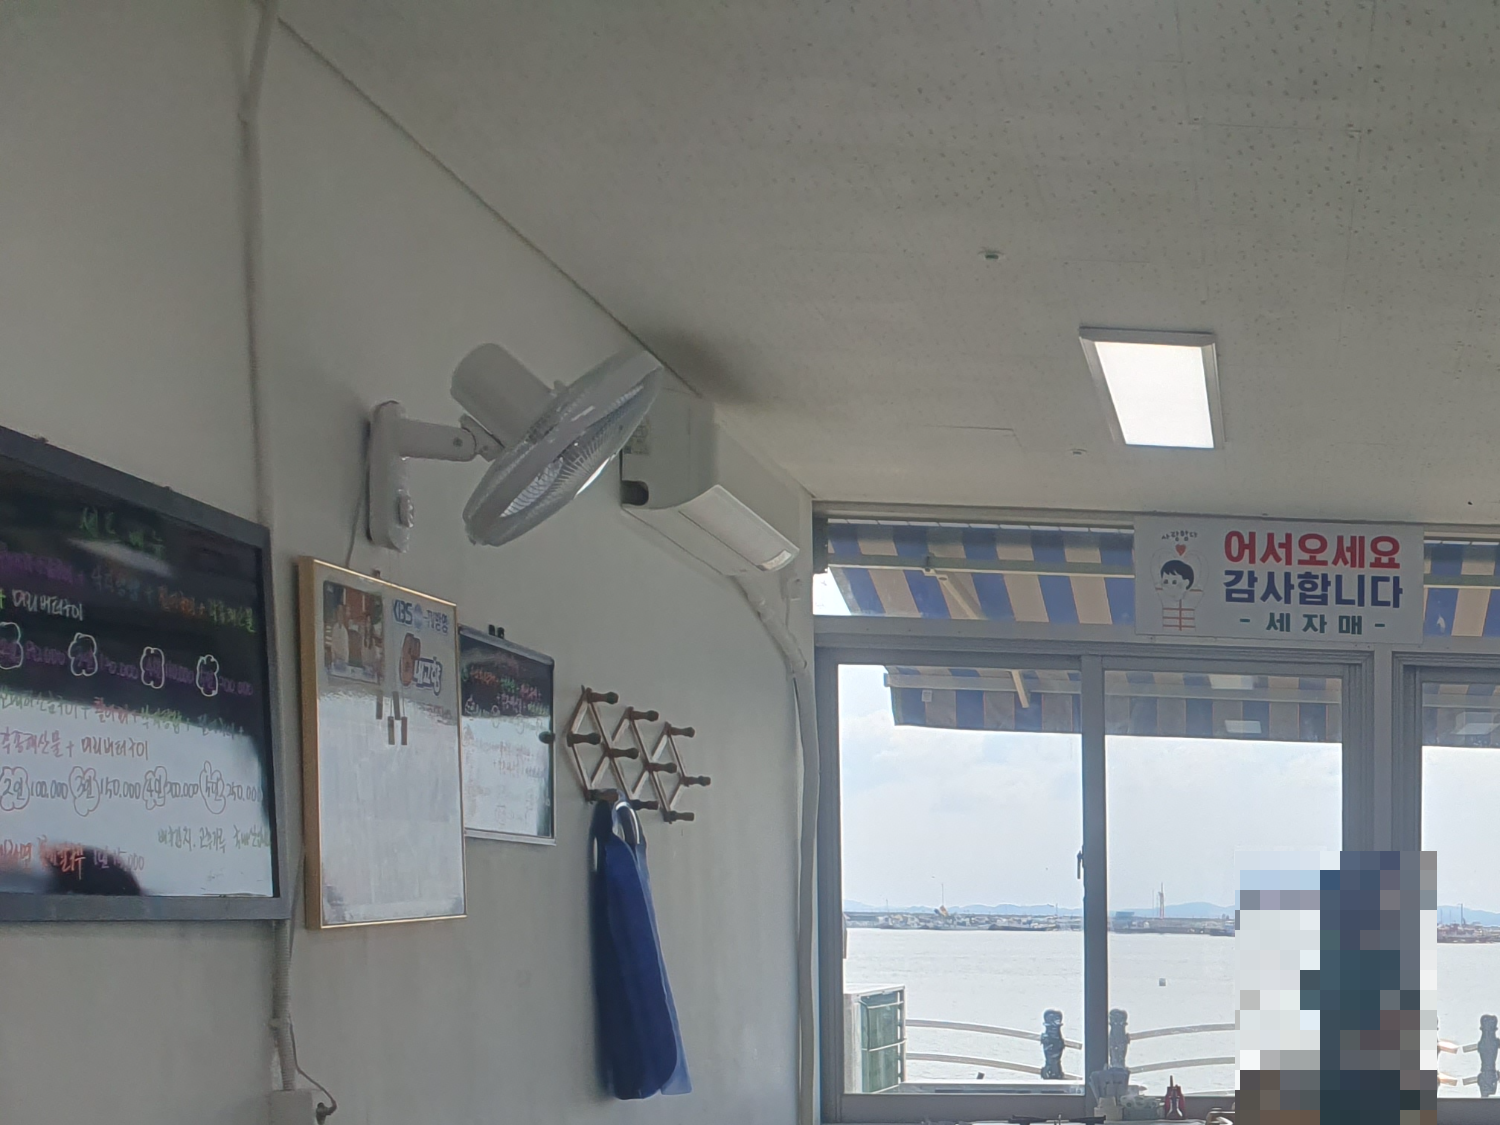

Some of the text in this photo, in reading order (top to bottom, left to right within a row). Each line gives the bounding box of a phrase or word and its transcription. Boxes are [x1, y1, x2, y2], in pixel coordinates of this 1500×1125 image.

[1224, 531, 1401, 569] 어서오세요
[1223, 570, 1403, 609] 감사합니다
[414, 656, 443, 696] 내고향
